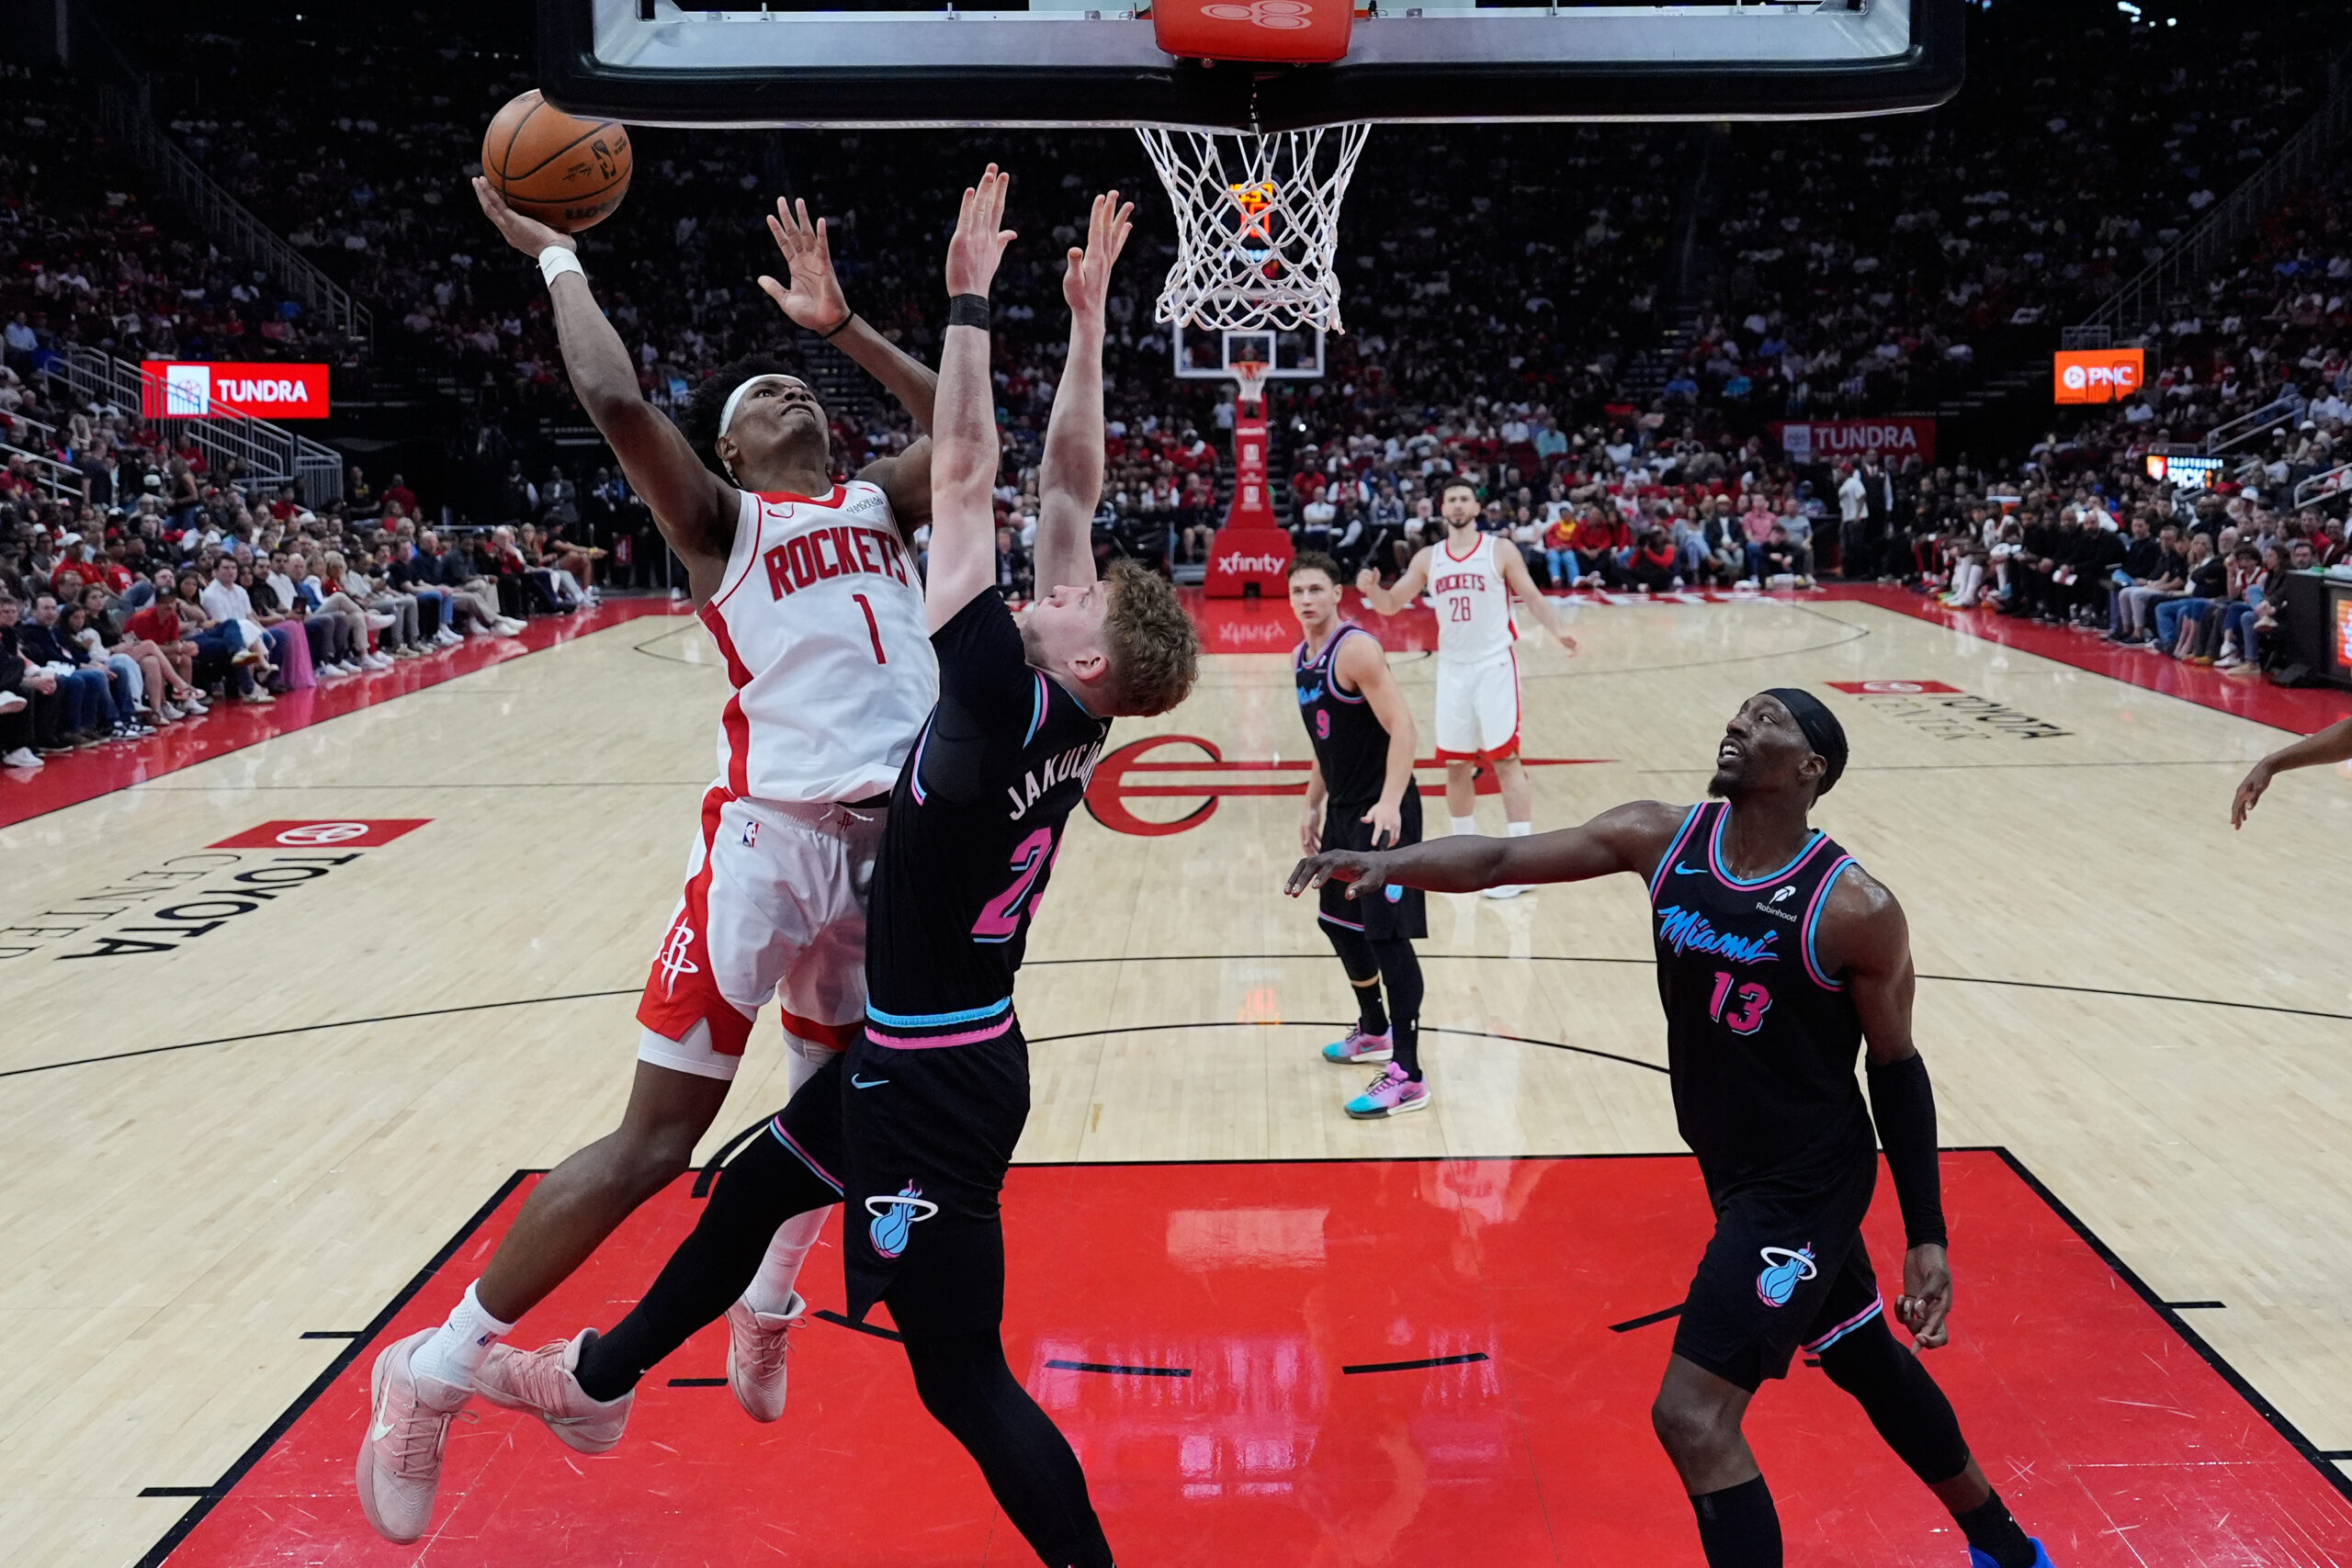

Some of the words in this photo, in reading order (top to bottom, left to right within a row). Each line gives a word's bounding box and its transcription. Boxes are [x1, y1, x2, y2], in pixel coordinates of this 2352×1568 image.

[217, 378, 309, 402] TUNDRA
[2086, 367, 2132, 386] PNC
[1814, 425, 1917, 449] TUNDRA
[763, 525, 909, 603] ROCKETS
[1217, 551, 1285, 575] xfinity
[1436, 573, 1485, 594] ROCKETS
[1449, 595, 1471, 622] 28
[852, 593, 888, 665] 1
[1317, 709, 1330, 739] 9
[54, 852, 364, 960] TOYOTA
[1737, 901, 1798, 923] Robinhood
[1657, 905, 1781, 964] Miami
[1710, 971, 1773, 1036] 13
